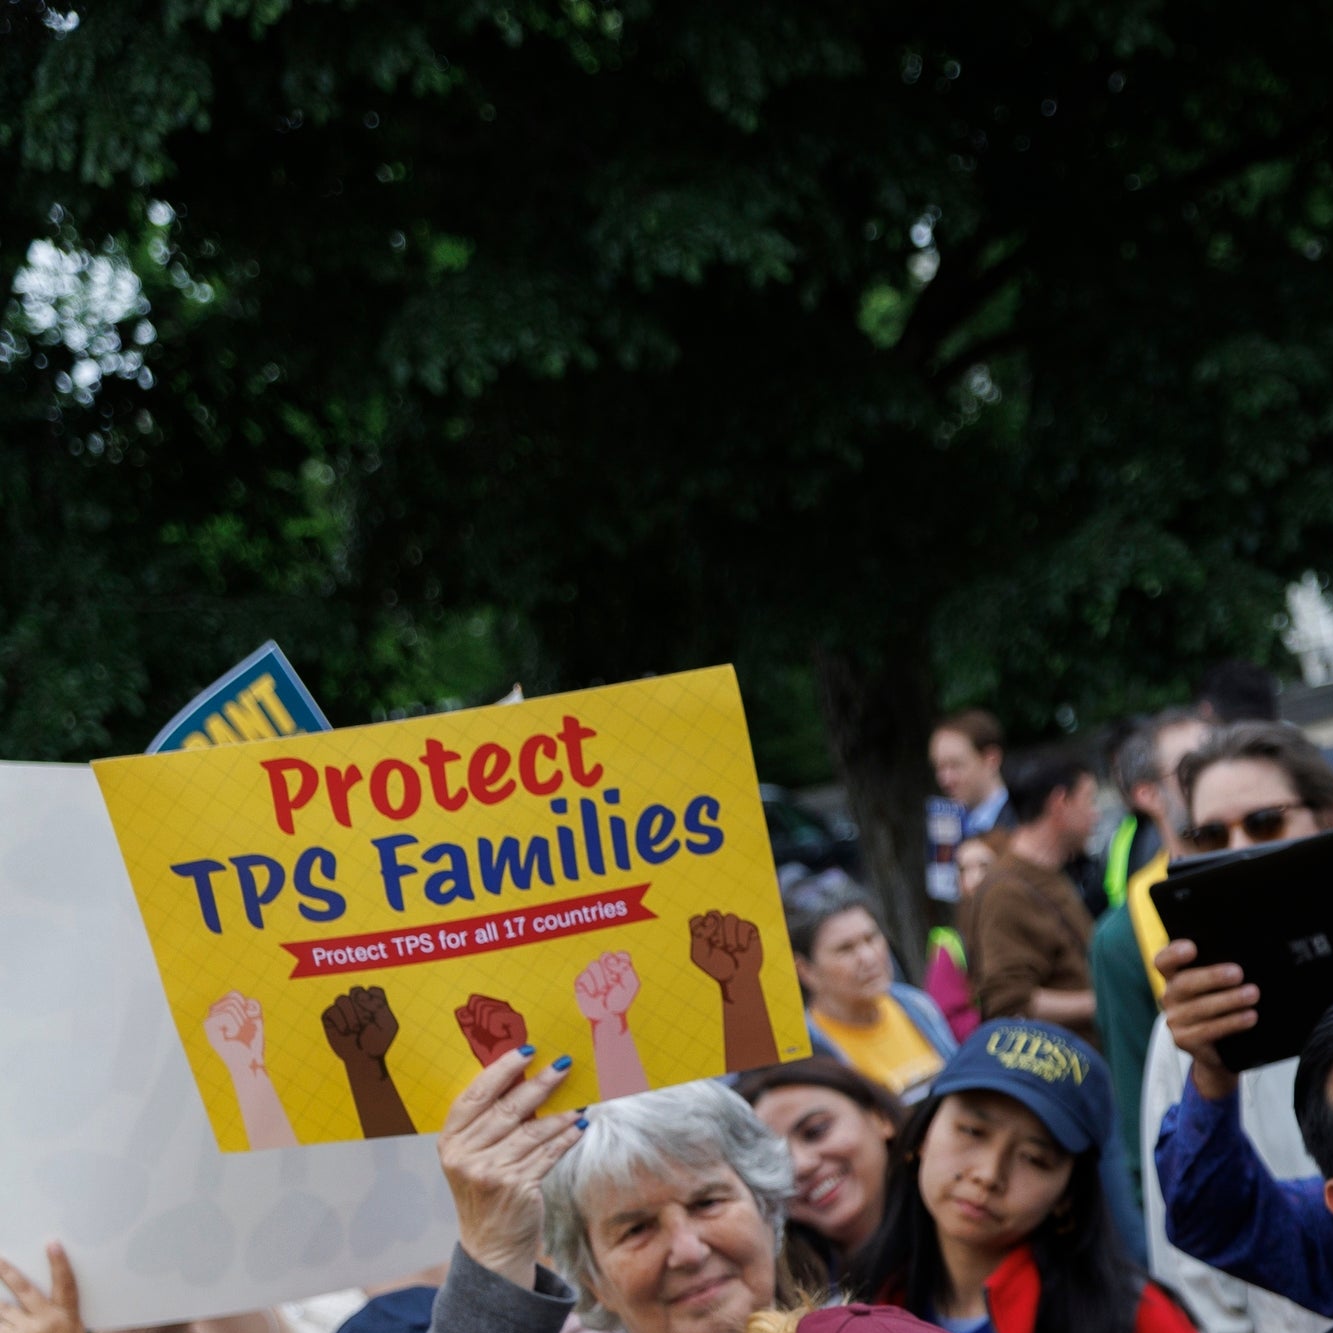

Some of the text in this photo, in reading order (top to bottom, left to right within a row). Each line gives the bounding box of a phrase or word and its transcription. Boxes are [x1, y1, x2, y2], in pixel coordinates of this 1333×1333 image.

[259, 714, 604, 836] Protect
[169, 787, 724, 935] TPS Families
[311, 899, 628, 967] Protect TPS for all 17 countries
